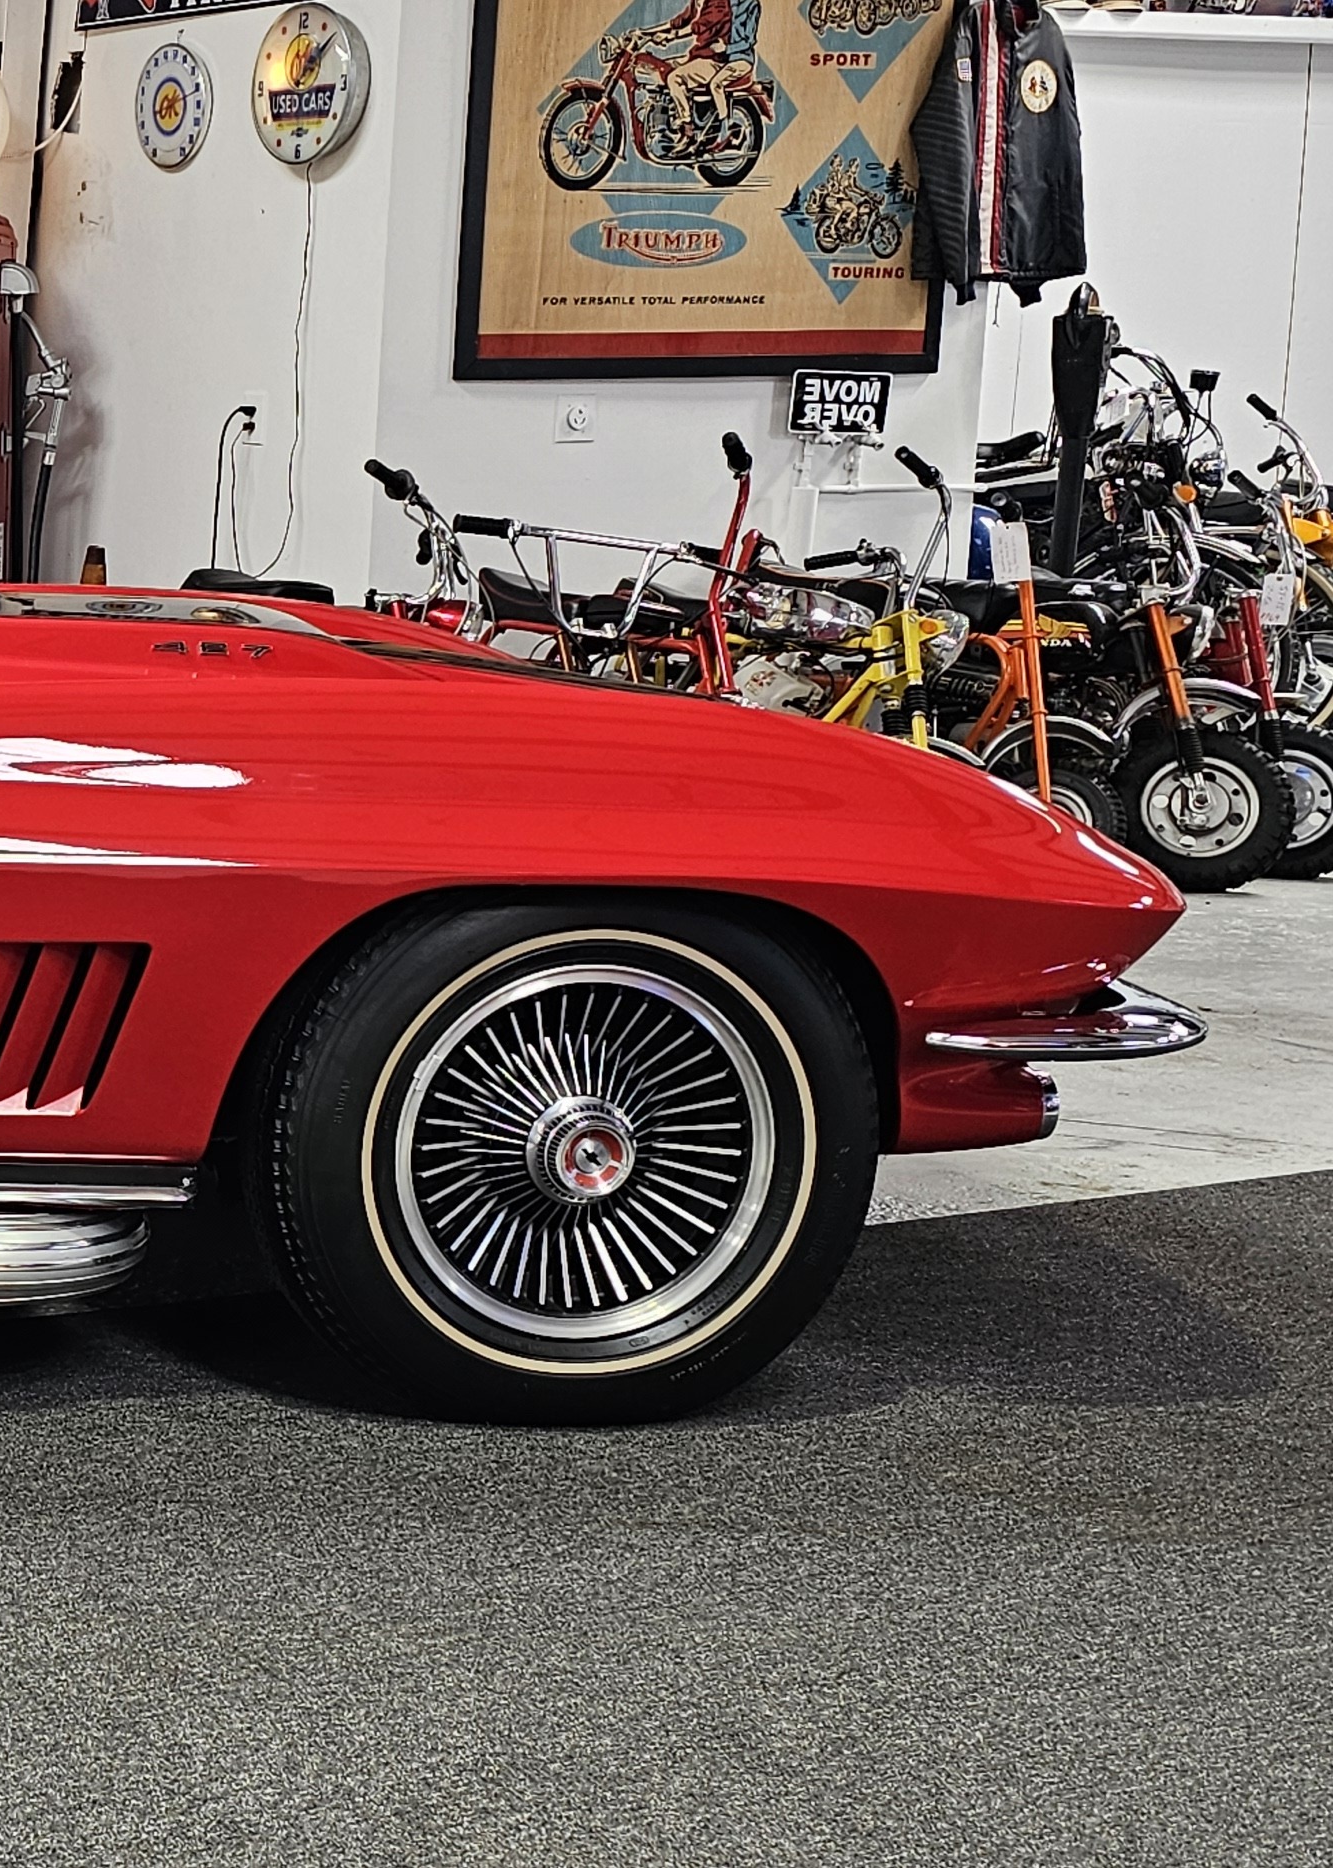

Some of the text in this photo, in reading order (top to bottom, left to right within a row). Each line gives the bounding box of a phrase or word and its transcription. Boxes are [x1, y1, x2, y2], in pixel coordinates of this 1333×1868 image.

[810, 53, 872, 67] SPORT
[273, 91, 331, 113] USED CARS
[601, 221, 724, 254] TRIUMPH
[832, 266, 905, 279] TOURING
[542, 295, 765, 306] FOR VERSATILE TOTAL PERFORMANCE
